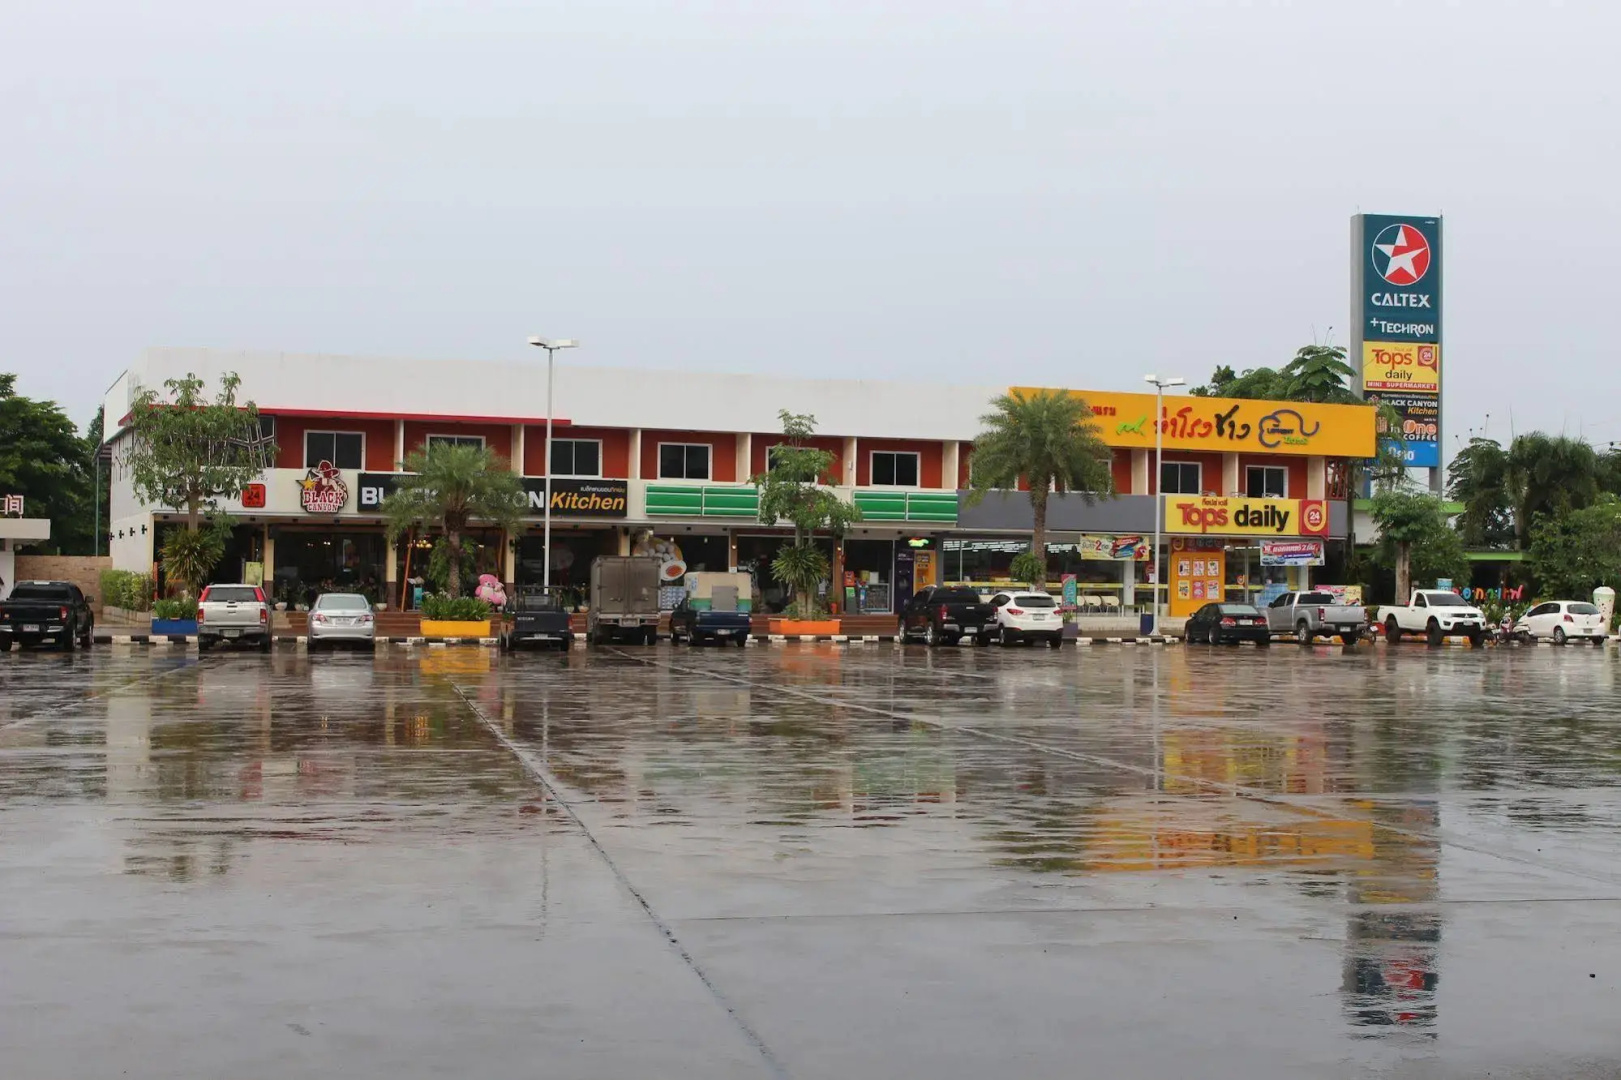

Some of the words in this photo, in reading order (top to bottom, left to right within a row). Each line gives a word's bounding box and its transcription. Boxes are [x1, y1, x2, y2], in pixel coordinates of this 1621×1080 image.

[1371, 293, 1431, 308] CALTEX
[1371, 349, 1413, 370] Tops
[1385, 370, 1413, 381] daily
[1407, 400, 1438, 408] CANYON
[1407, 407, 1438, 415] Kitchen
[303, 491, 343, 504] BLACK
[550, 491, 625, 510] Kitchen
[308, 503, 338, 511] CANYON
[1176, 503, 1228, 533] Tops
[1234, 504, 1290, 532] daily
[1310, 511, 1320, 520] 24
